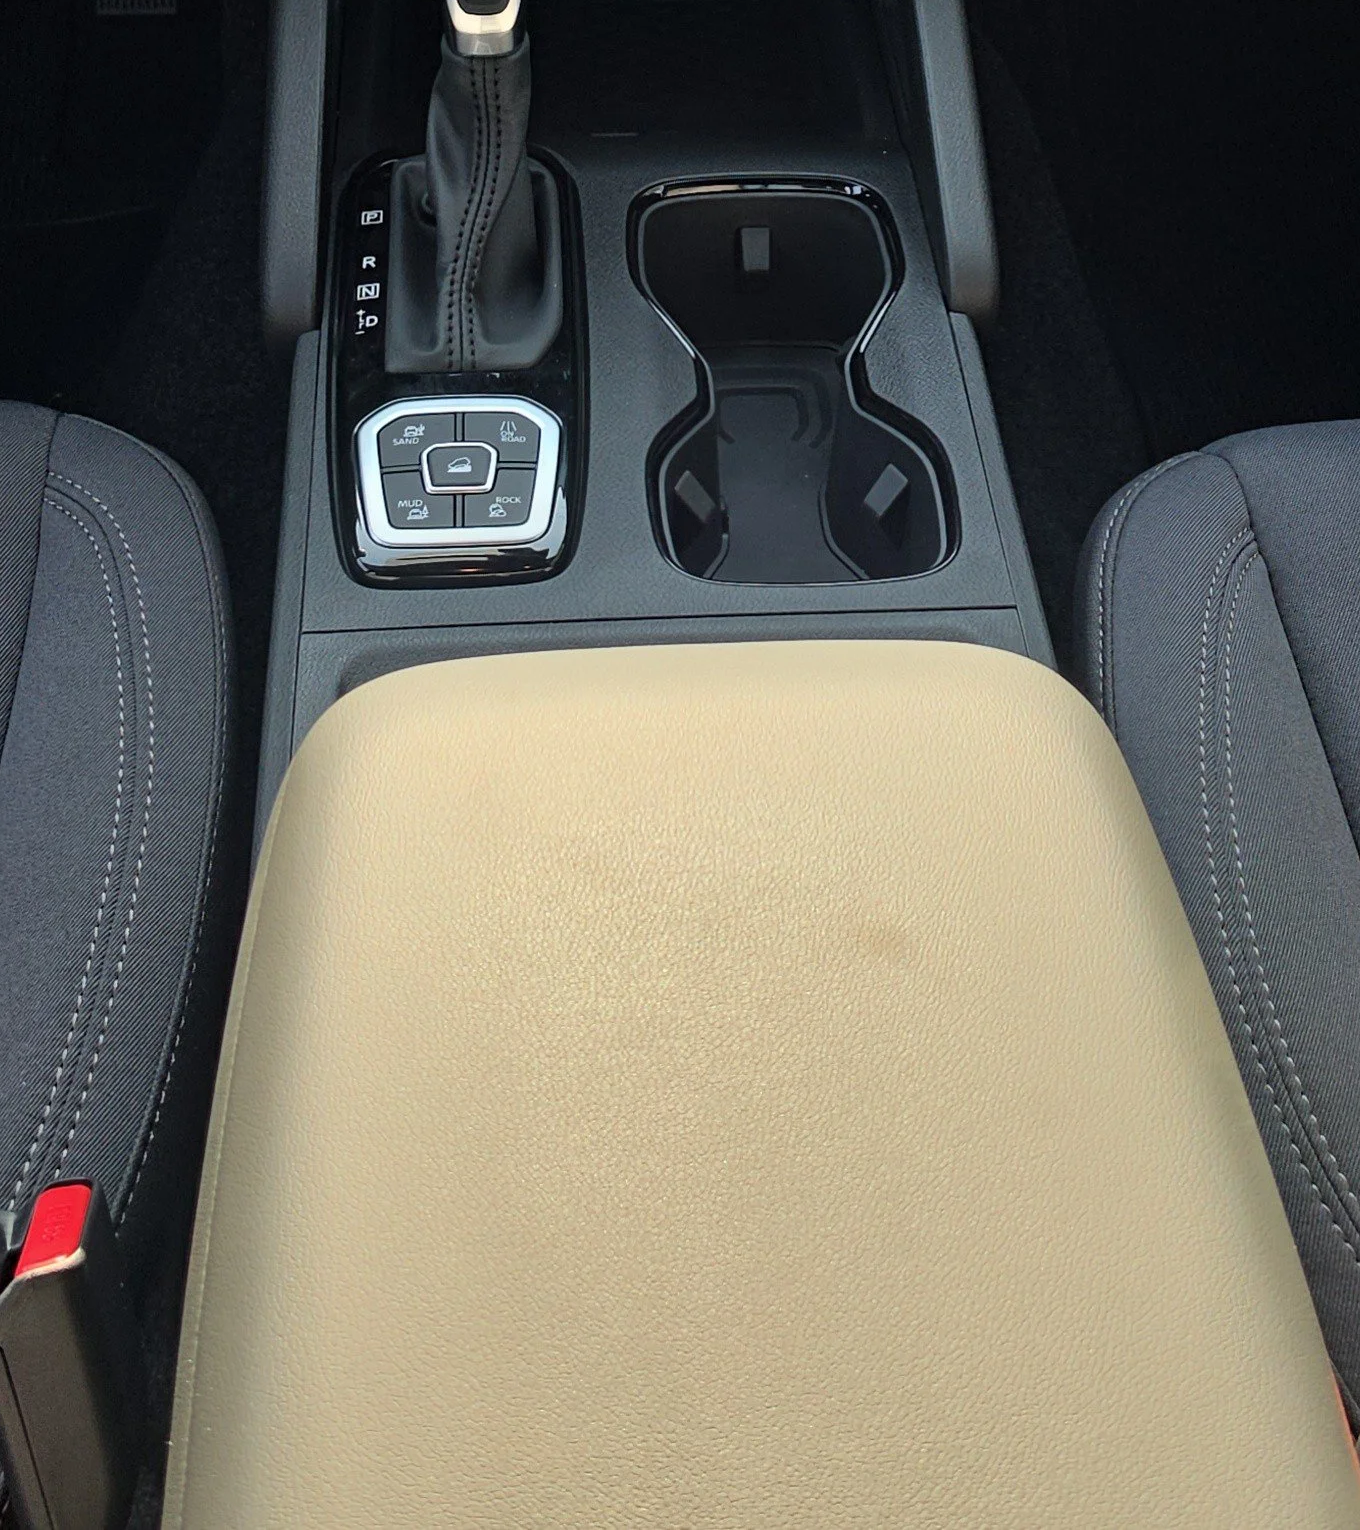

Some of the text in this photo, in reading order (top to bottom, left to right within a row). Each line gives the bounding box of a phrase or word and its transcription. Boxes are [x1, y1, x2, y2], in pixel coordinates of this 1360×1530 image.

[362, 256, 376, 269] R
[365, 314, 378, 328] D
[392, 437, 420, 446] SAND
[397, 499, 423, 508] MUD
[495, 496, 522, 504] ROCK
